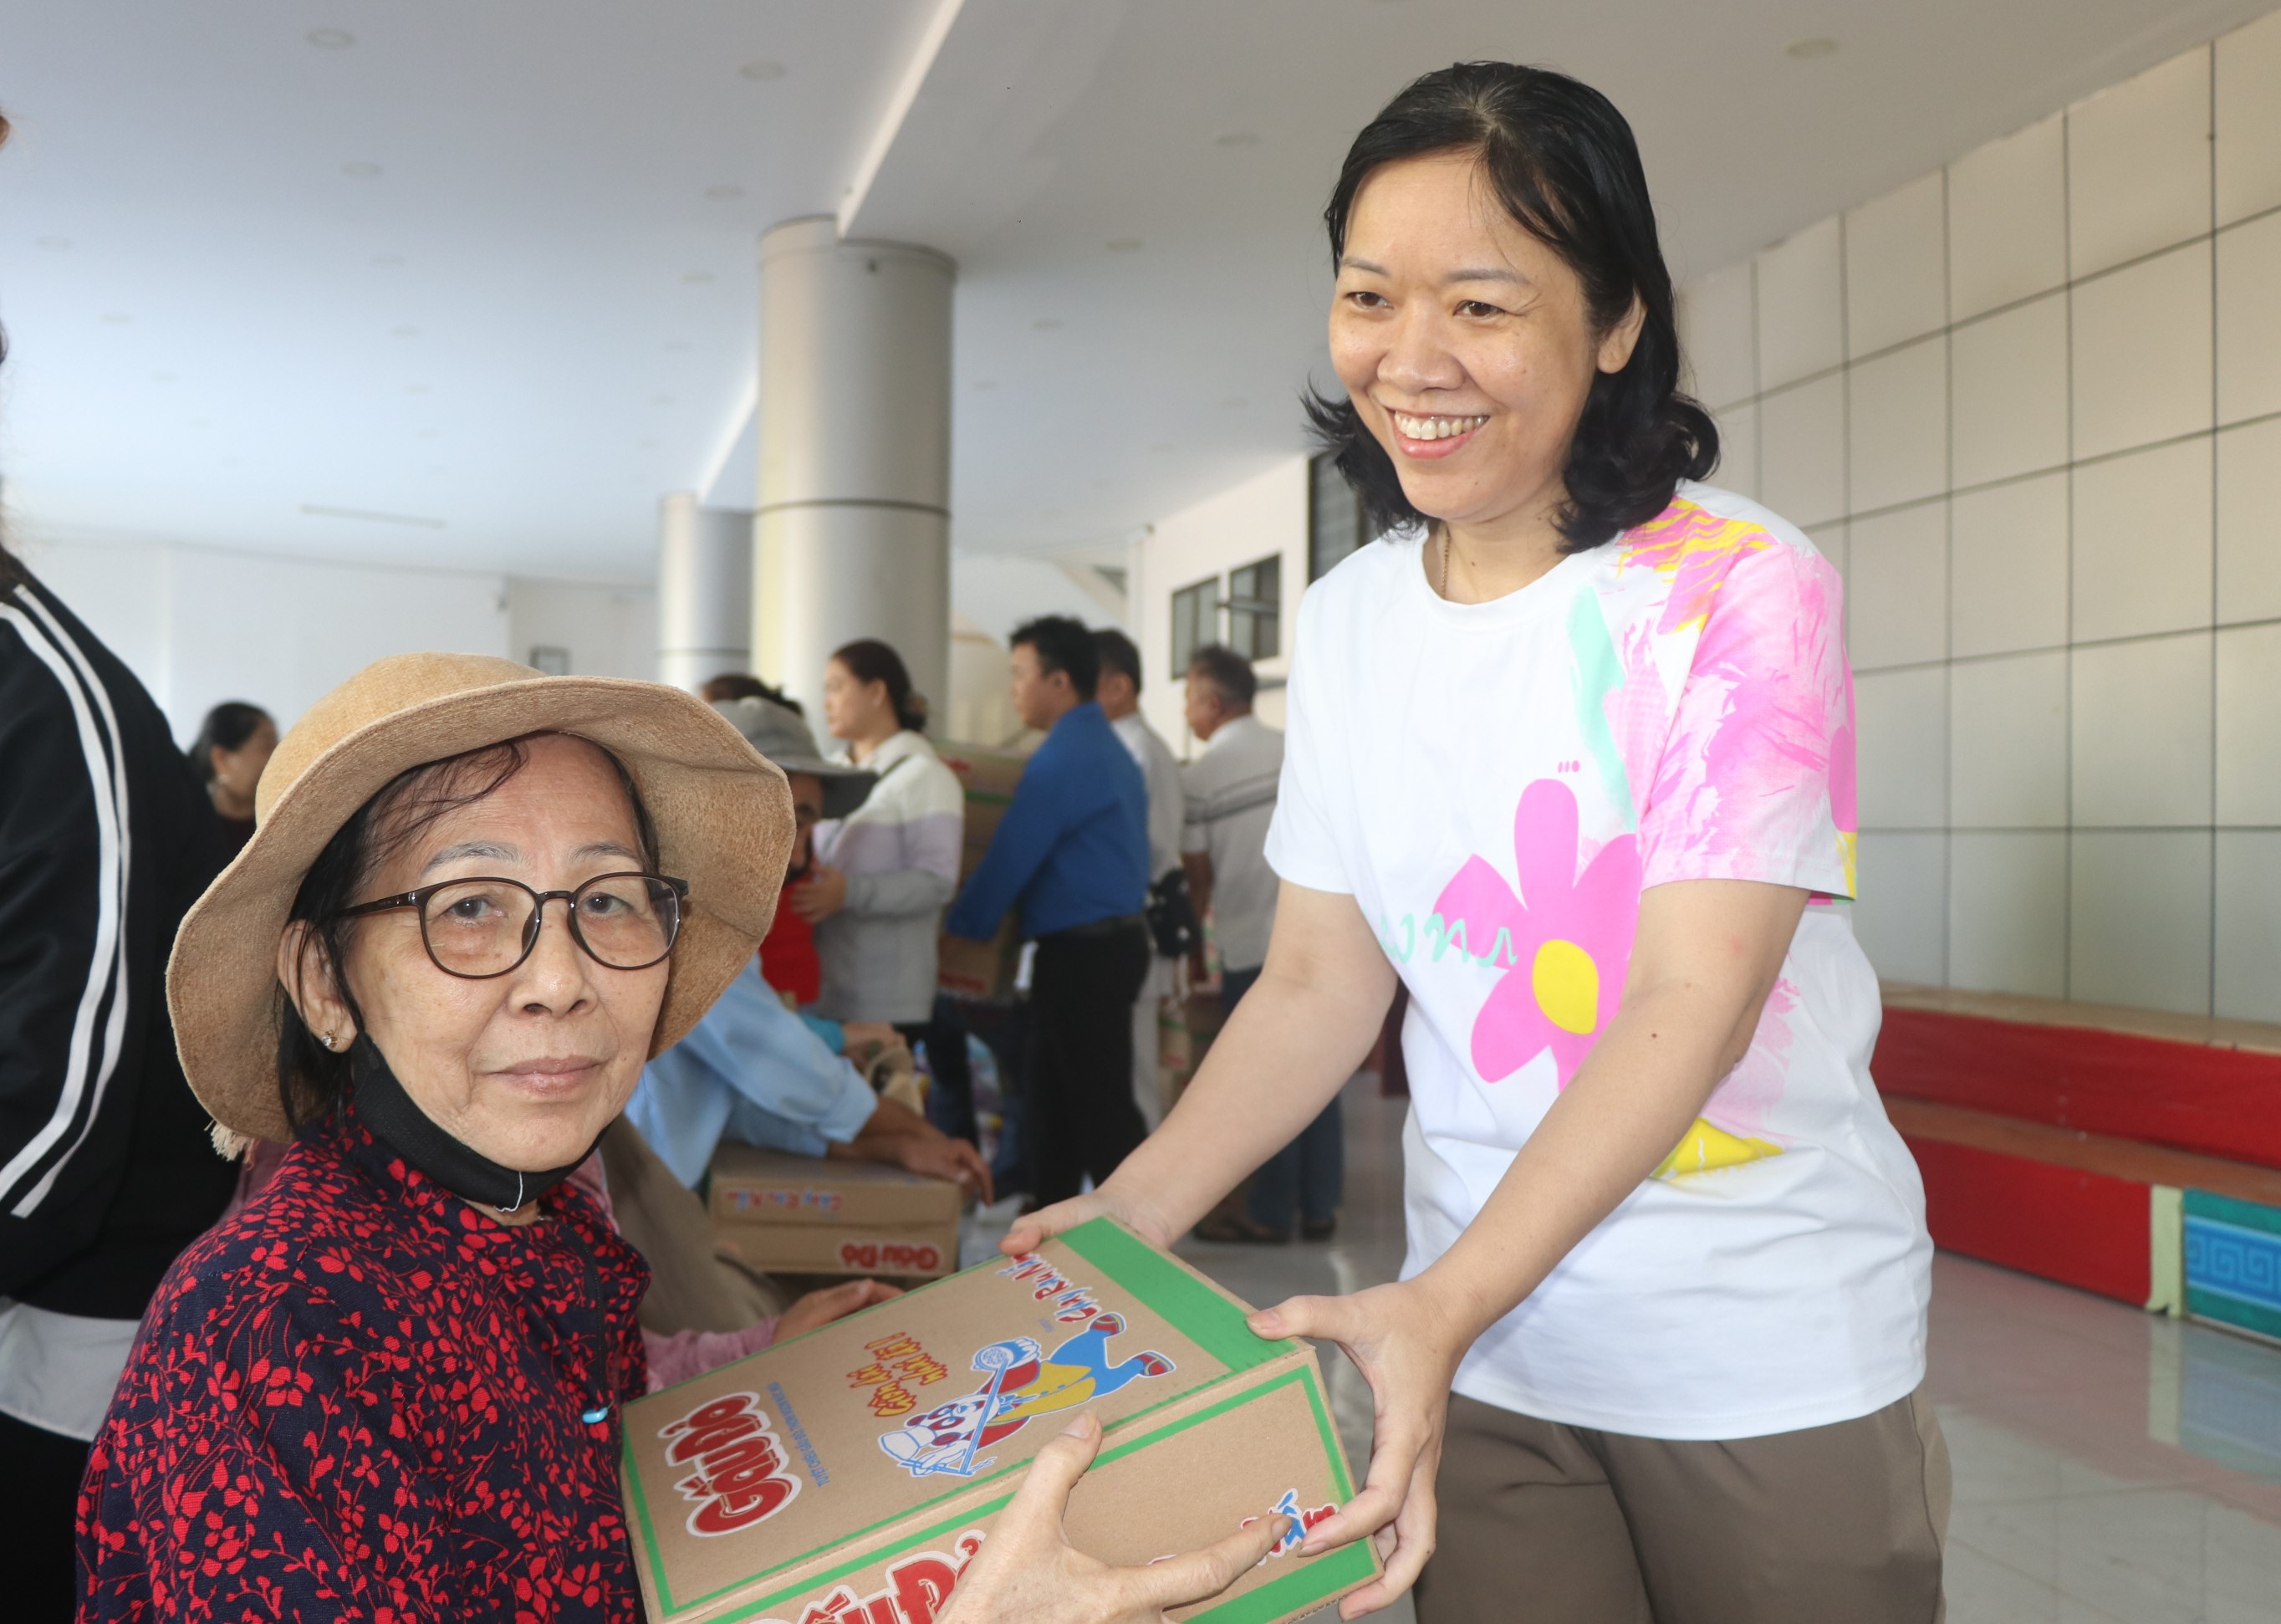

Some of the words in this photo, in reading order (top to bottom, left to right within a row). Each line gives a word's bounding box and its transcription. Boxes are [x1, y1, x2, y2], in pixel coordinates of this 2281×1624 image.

[1033, 1267, 1073, 1301] Rau
[1053, 1286, 1101, 1322] Chay
[867, 1381, 917, 1417] Giòn
[658, 1392, 769, 1466] Đỏ
[675, 1432, 801, 1536] Gấu
